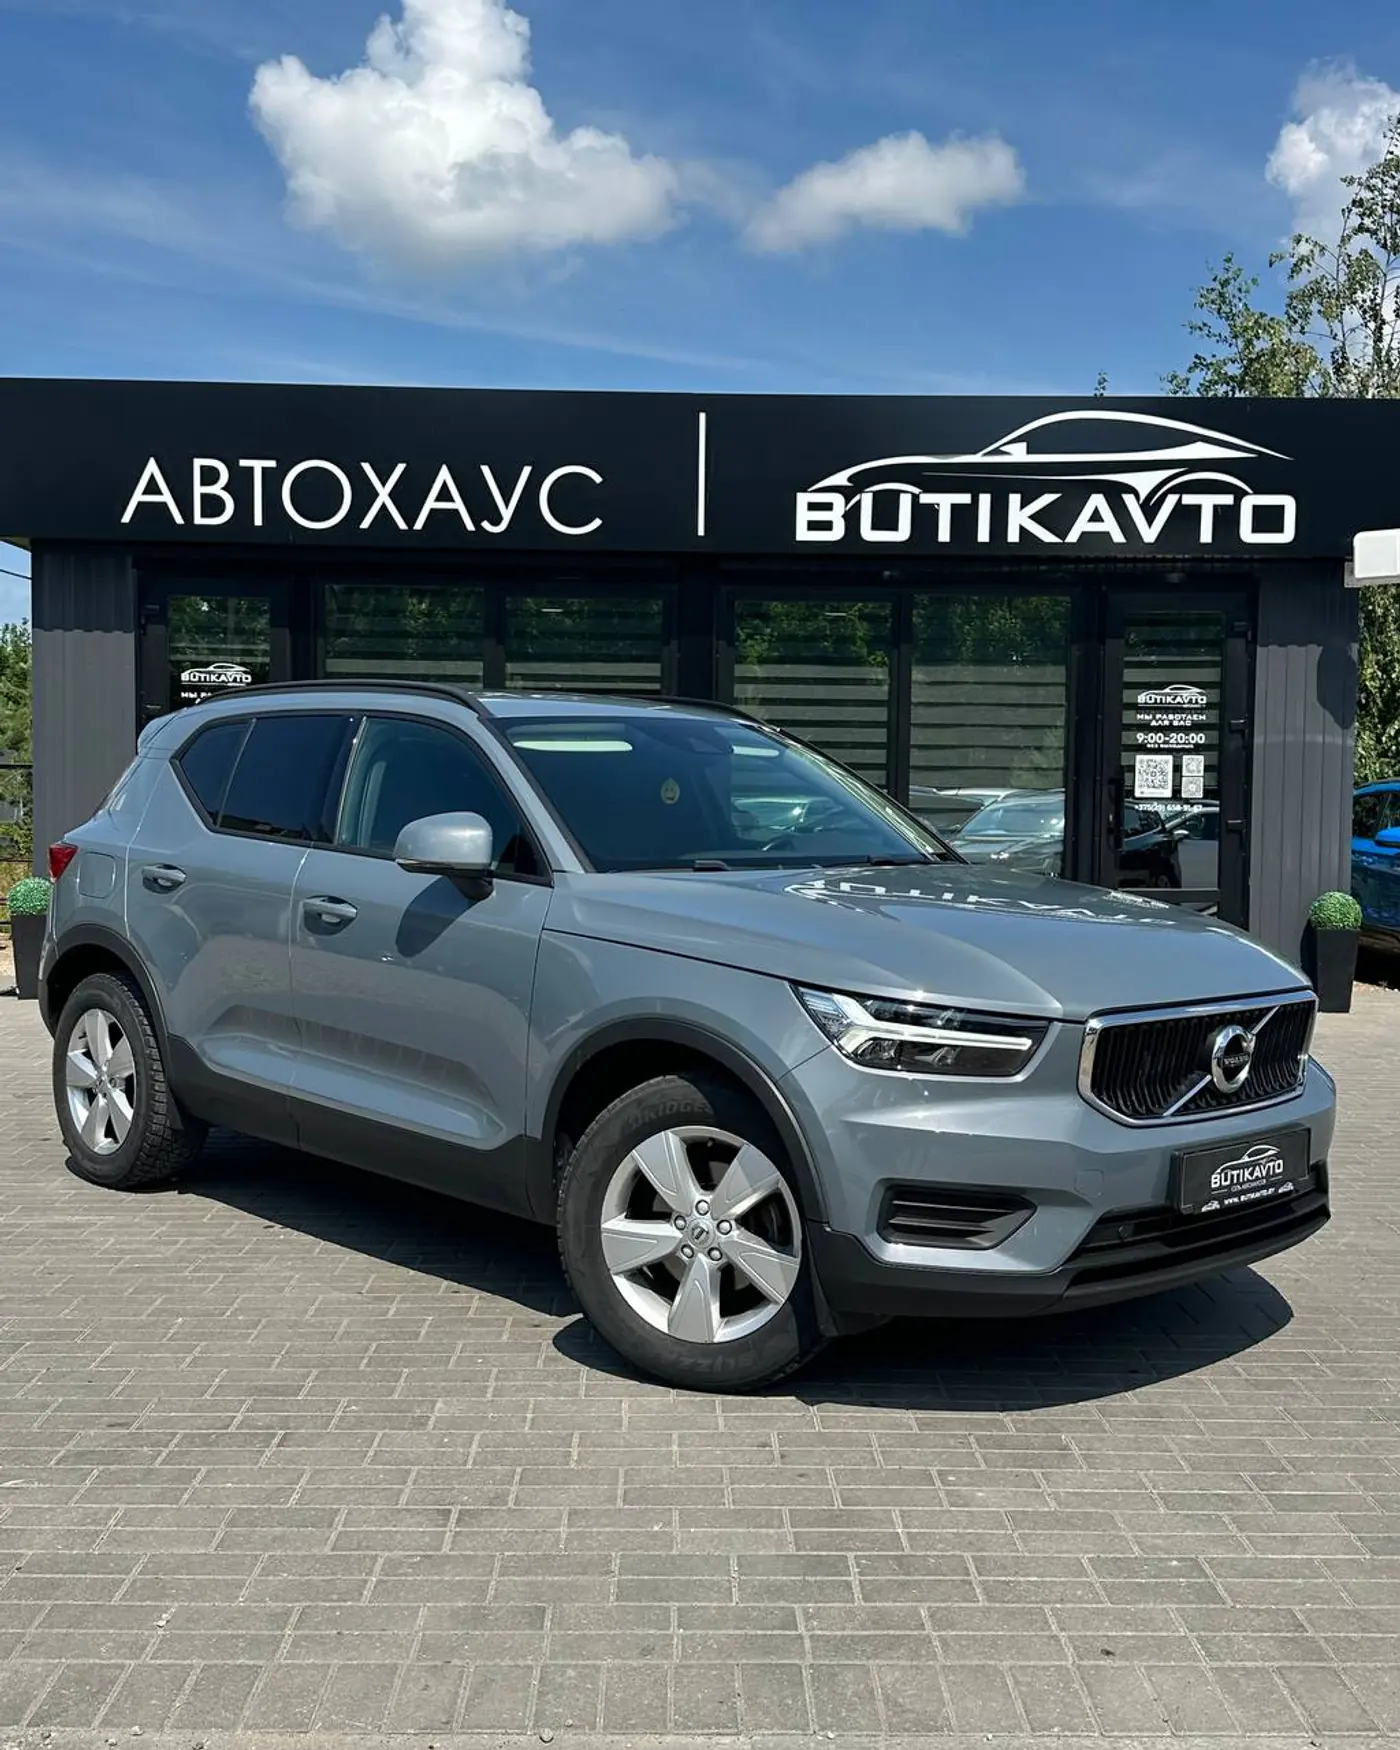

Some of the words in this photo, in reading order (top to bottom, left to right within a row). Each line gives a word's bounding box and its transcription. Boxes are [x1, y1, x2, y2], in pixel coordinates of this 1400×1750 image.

[120, 456, 604, 536] АВТОХАУС
[795, 491, 1297, 544] BUTIKAVTO
[181, 672, 252, 682] BUTIKAVTO
[1137, 694, 1207, 704] BUTIKAVTO
[1136, 732, 1206, 744] 9:00-20:00
[1210, 1158, 1284, 1189] BUTIKAVTO
